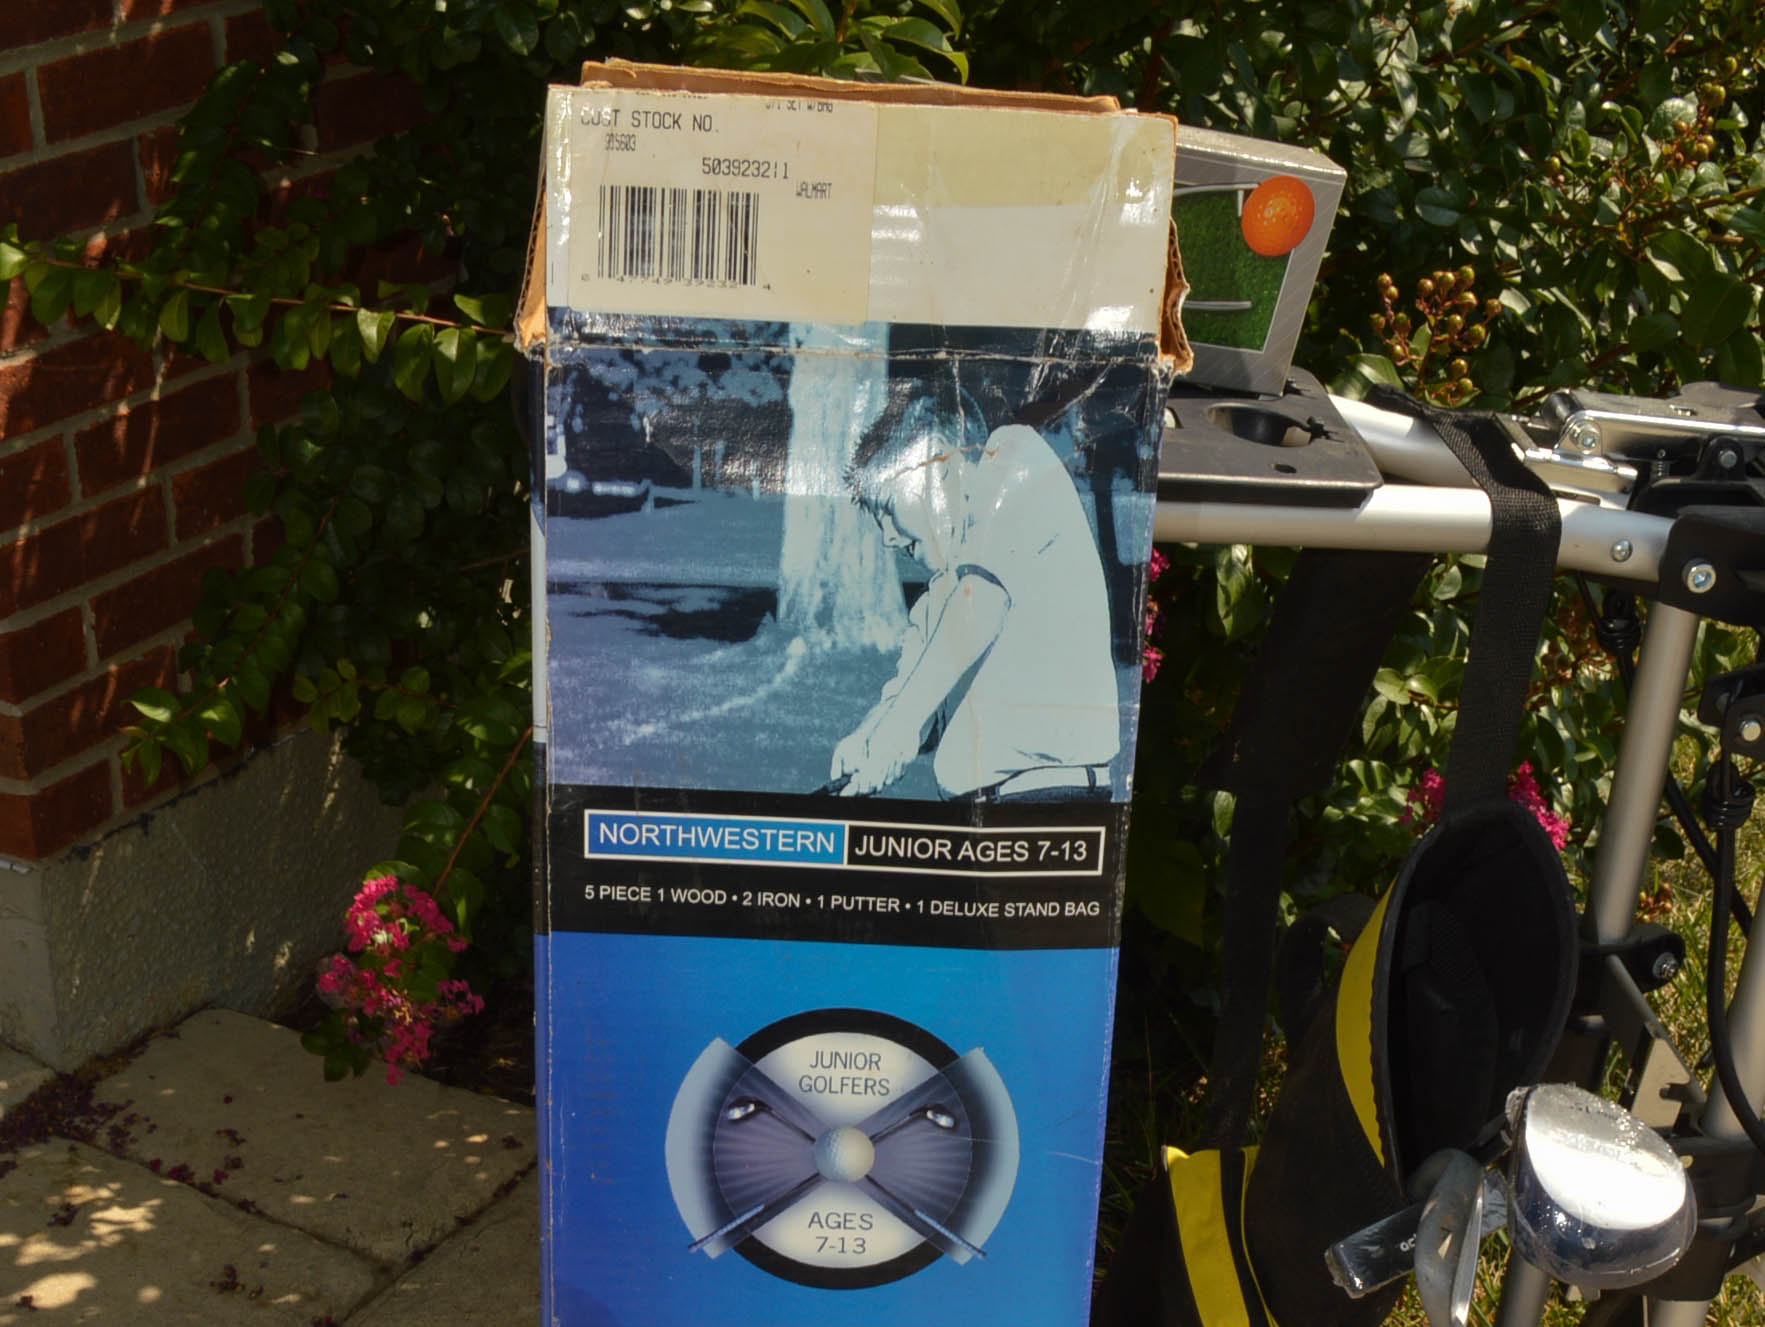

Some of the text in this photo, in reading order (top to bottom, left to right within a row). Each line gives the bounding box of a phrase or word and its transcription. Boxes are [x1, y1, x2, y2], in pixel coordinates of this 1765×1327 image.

[581, 105, 719, 133] CUST STOCK NO.
[702, 157, 788, 179] 503923211
[599, 822, 1088, 862] NORTHWESTERN JUNIOR AGES 7-13
[585, 885, 1100, 917] 5 PIECE 1 WOOD 2 IRON 1 PUTTER 1 DELUXE STAND BAG
[809, 1050, 881, 1071] JUNIOR
[798, 1074, 891, 1096] GOLFERS
[807, 1211, 874, 1232] AGES
[815, 1236, 866, 1255] 7-13
